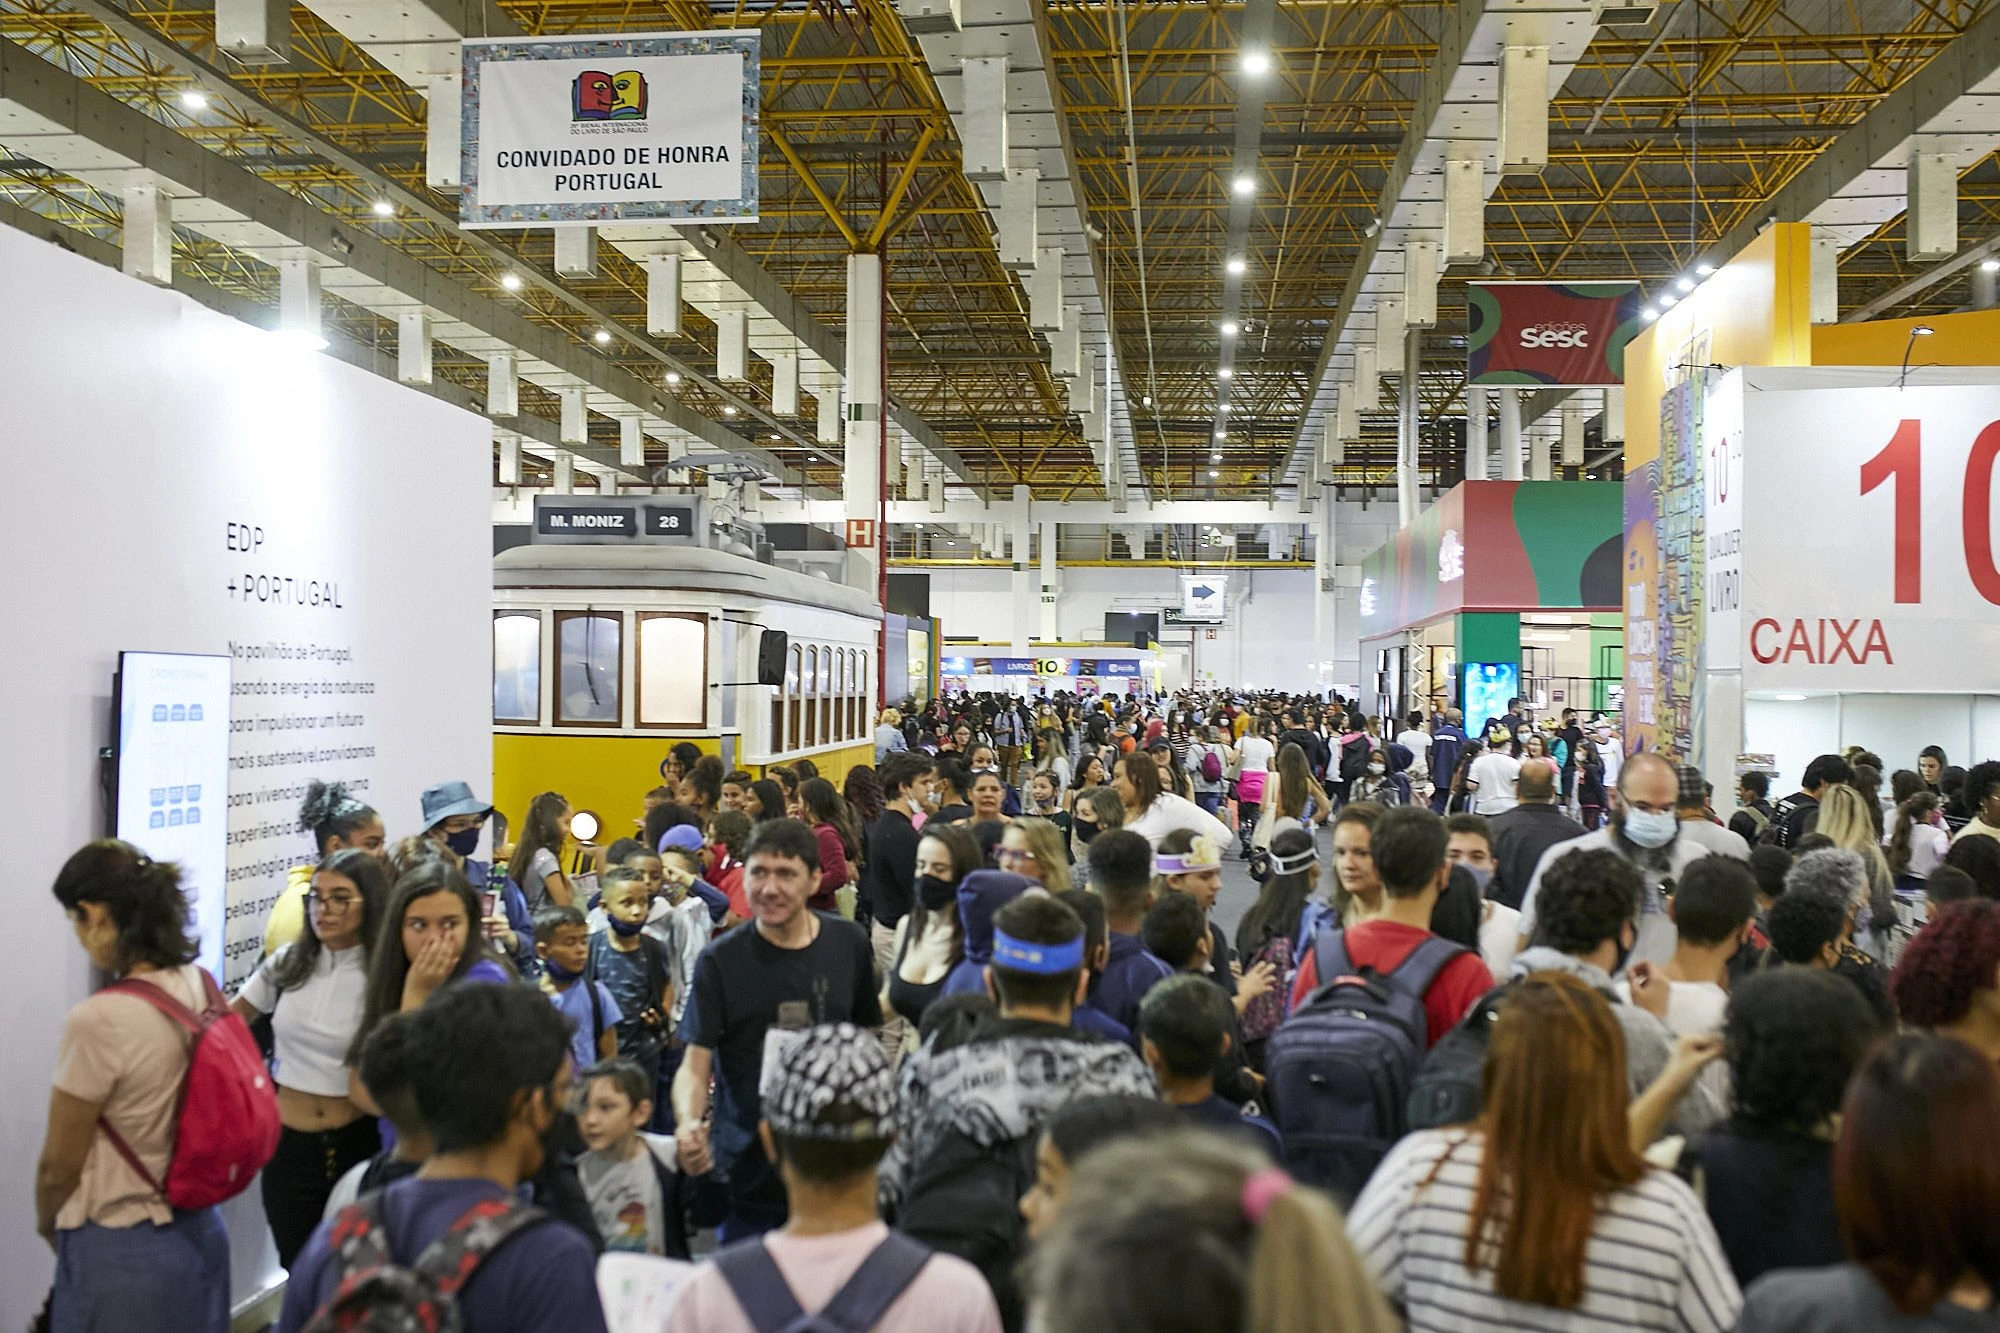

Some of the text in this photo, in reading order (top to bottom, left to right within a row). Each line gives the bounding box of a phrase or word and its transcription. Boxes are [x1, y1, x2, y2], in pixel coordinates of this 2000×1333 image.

[612, 126, 625, 134] SÃO
[627, 126, 649, 134] PAULO
[497, 146, 730, 168] CONVIDADO DE HONRA
[555, 172, 663, 191] PORTUGAL
[550, 515, 624, 528] M. MONIZ
[659, 516, 680, 529] 28
[227, 522, 264, 554] EDP
[851, 521, 871, 545] H
[1710, 568, 1740, 613] LIVRO
[228, 641, 243, 658] No
[246, 642, 292, 662] pavilhão
[296, 645, 307, 660] de
[1750, 617, 1894, 665] CAIXA
[1007, 660, 1058, 673] LIVROS 10
[272, 682, 278, 694] a
[281, 678, 319, 699] energia
[321, 678, 332, 694] da
[335, 679, 375, 694] natureza
[256, 713, 317, 735] impulsionar
[320, 716, 334, 728] um
[337, 711, 364, 727] futuro
[229, 751, 254, 770] mais
[256, 782, 306, 803] vivenciar
[226, 821, 292, 848] experiência
[226, 855, 284, 882] tecnologia
[288, 857, 293, 870] e
[225, 899, 256, 925] pelas
